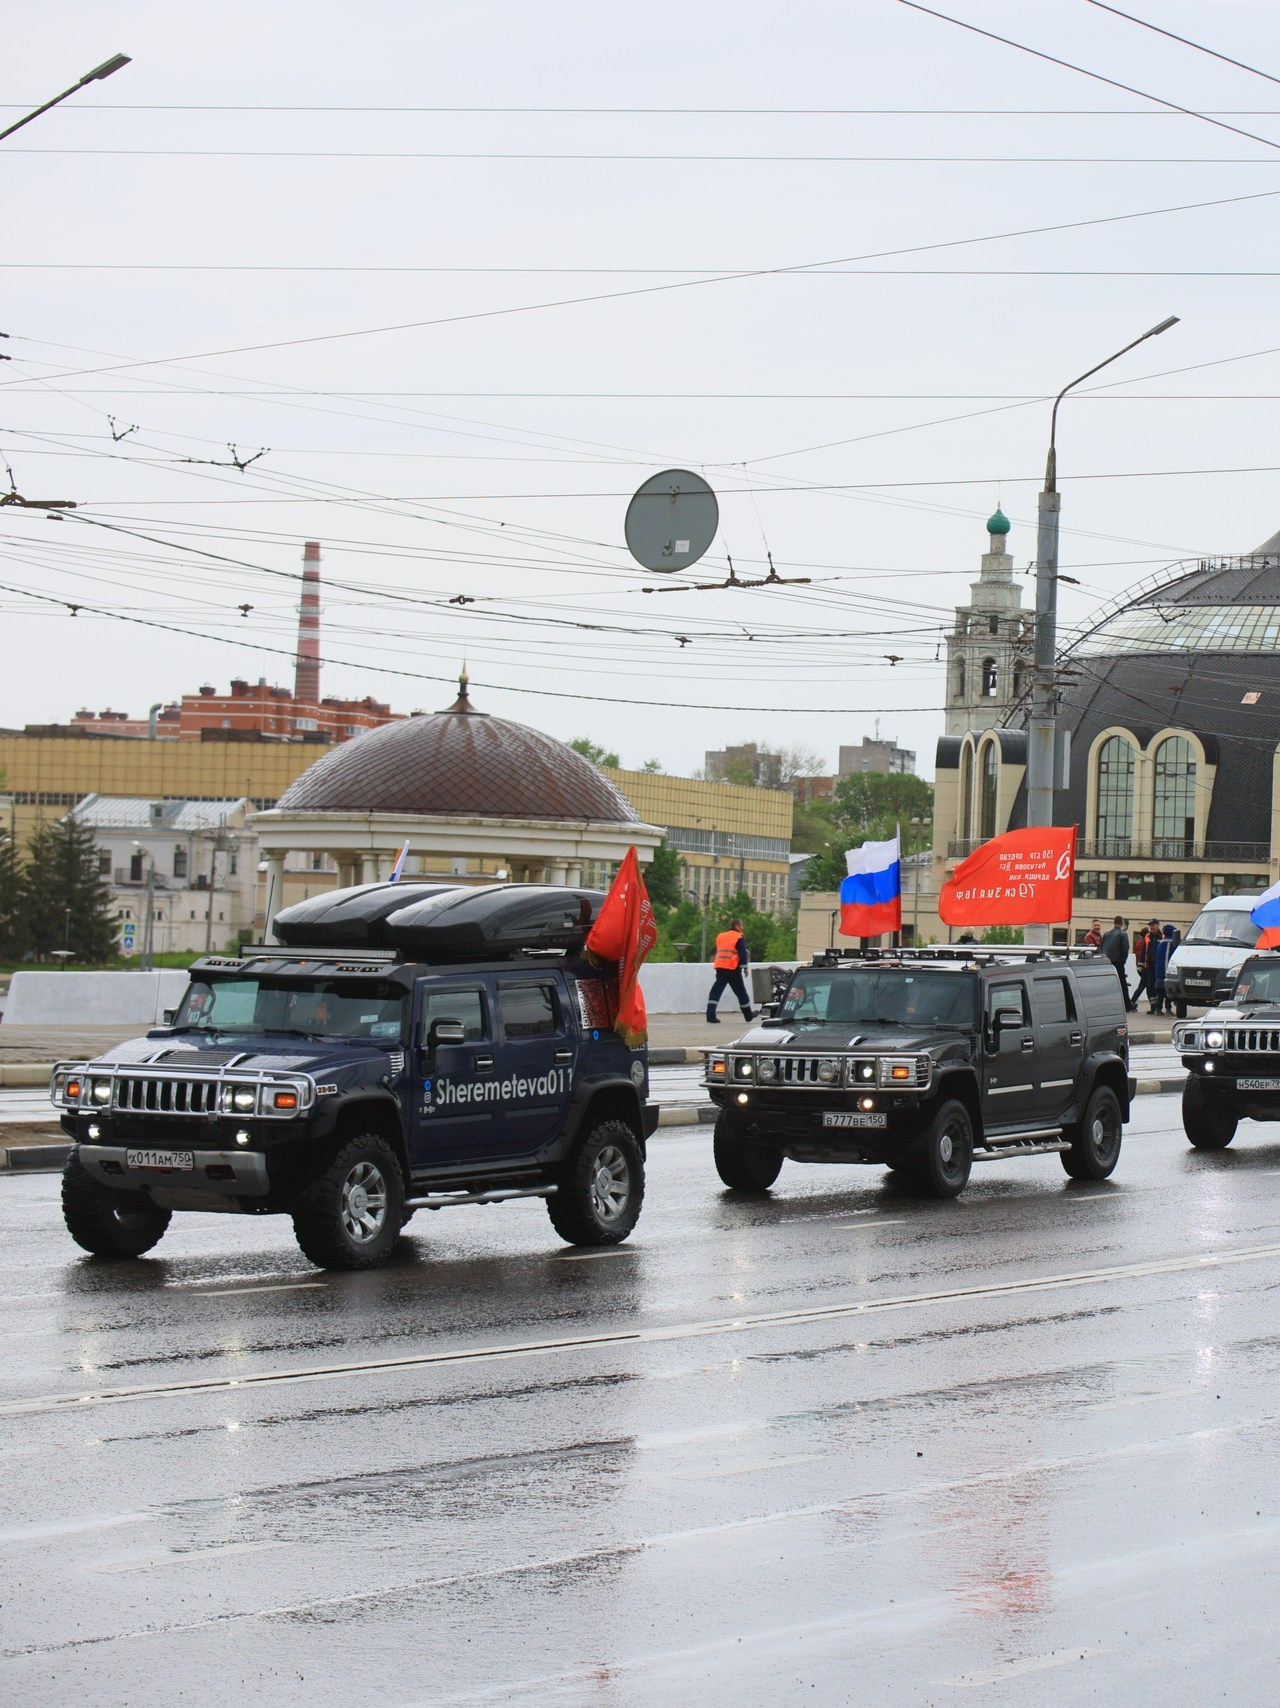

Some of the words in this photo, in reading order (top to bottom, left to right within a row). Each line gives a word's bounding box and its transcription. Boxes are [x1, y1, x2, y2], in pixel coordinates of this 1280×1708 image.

[436, 1067, 573, 1105] Sheremeteva011
[826, 1115, 866, 1126] В777ВЕ
[868, 1115, 883, 1124] 150
[130, 1152, 172, 1165] Х011АМ
[172, 1152, 191, 1163] 750
